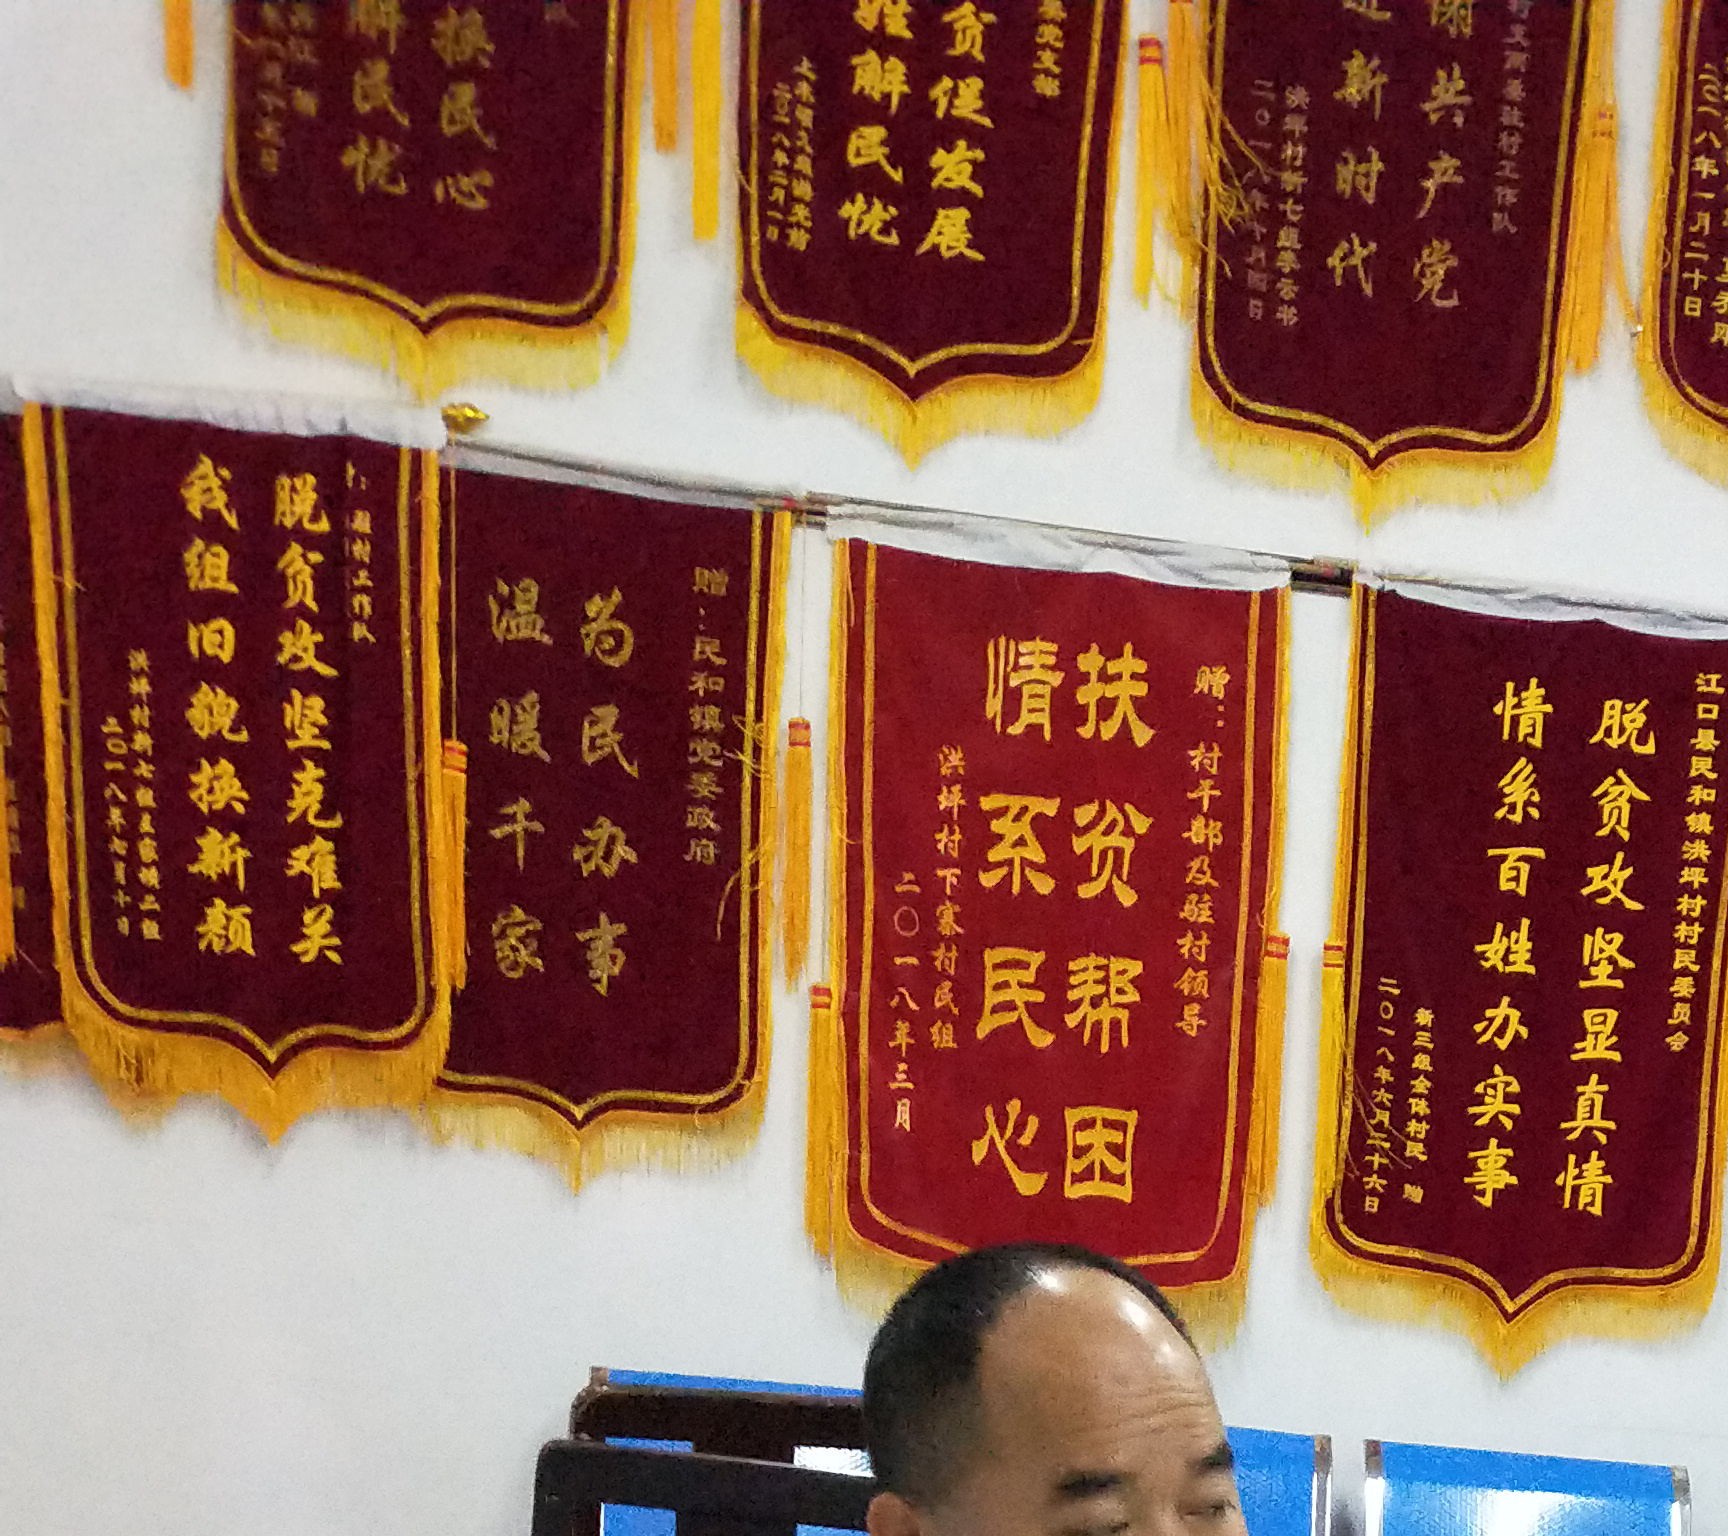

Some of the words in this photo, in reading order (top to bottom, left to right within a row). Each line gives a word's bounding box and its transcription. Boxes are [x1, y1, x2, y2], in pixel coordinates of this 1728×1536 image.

[1327, 0, 1393, 298] 新时代
[178, 452, 257, 958] 我组旧貌换新颜
[273, 470, 345, 966] 脱贫攻坚克难关
[488, 577, 553, 980] 温暖千家
[573, 585, 639, 998] 为民办事
[970, 634, 1067, 1198] 情系民心
[1062, 641, 1157, 1206] 扶贫帮困
[1462, 676, 1555, 1209] 情系百姓办实事
[1664, 672, 1726, 1054] 江口县民和镇洪坪村村民委员会
[1554, 697, 1658, 1217] 脱贫攻坚显真情
